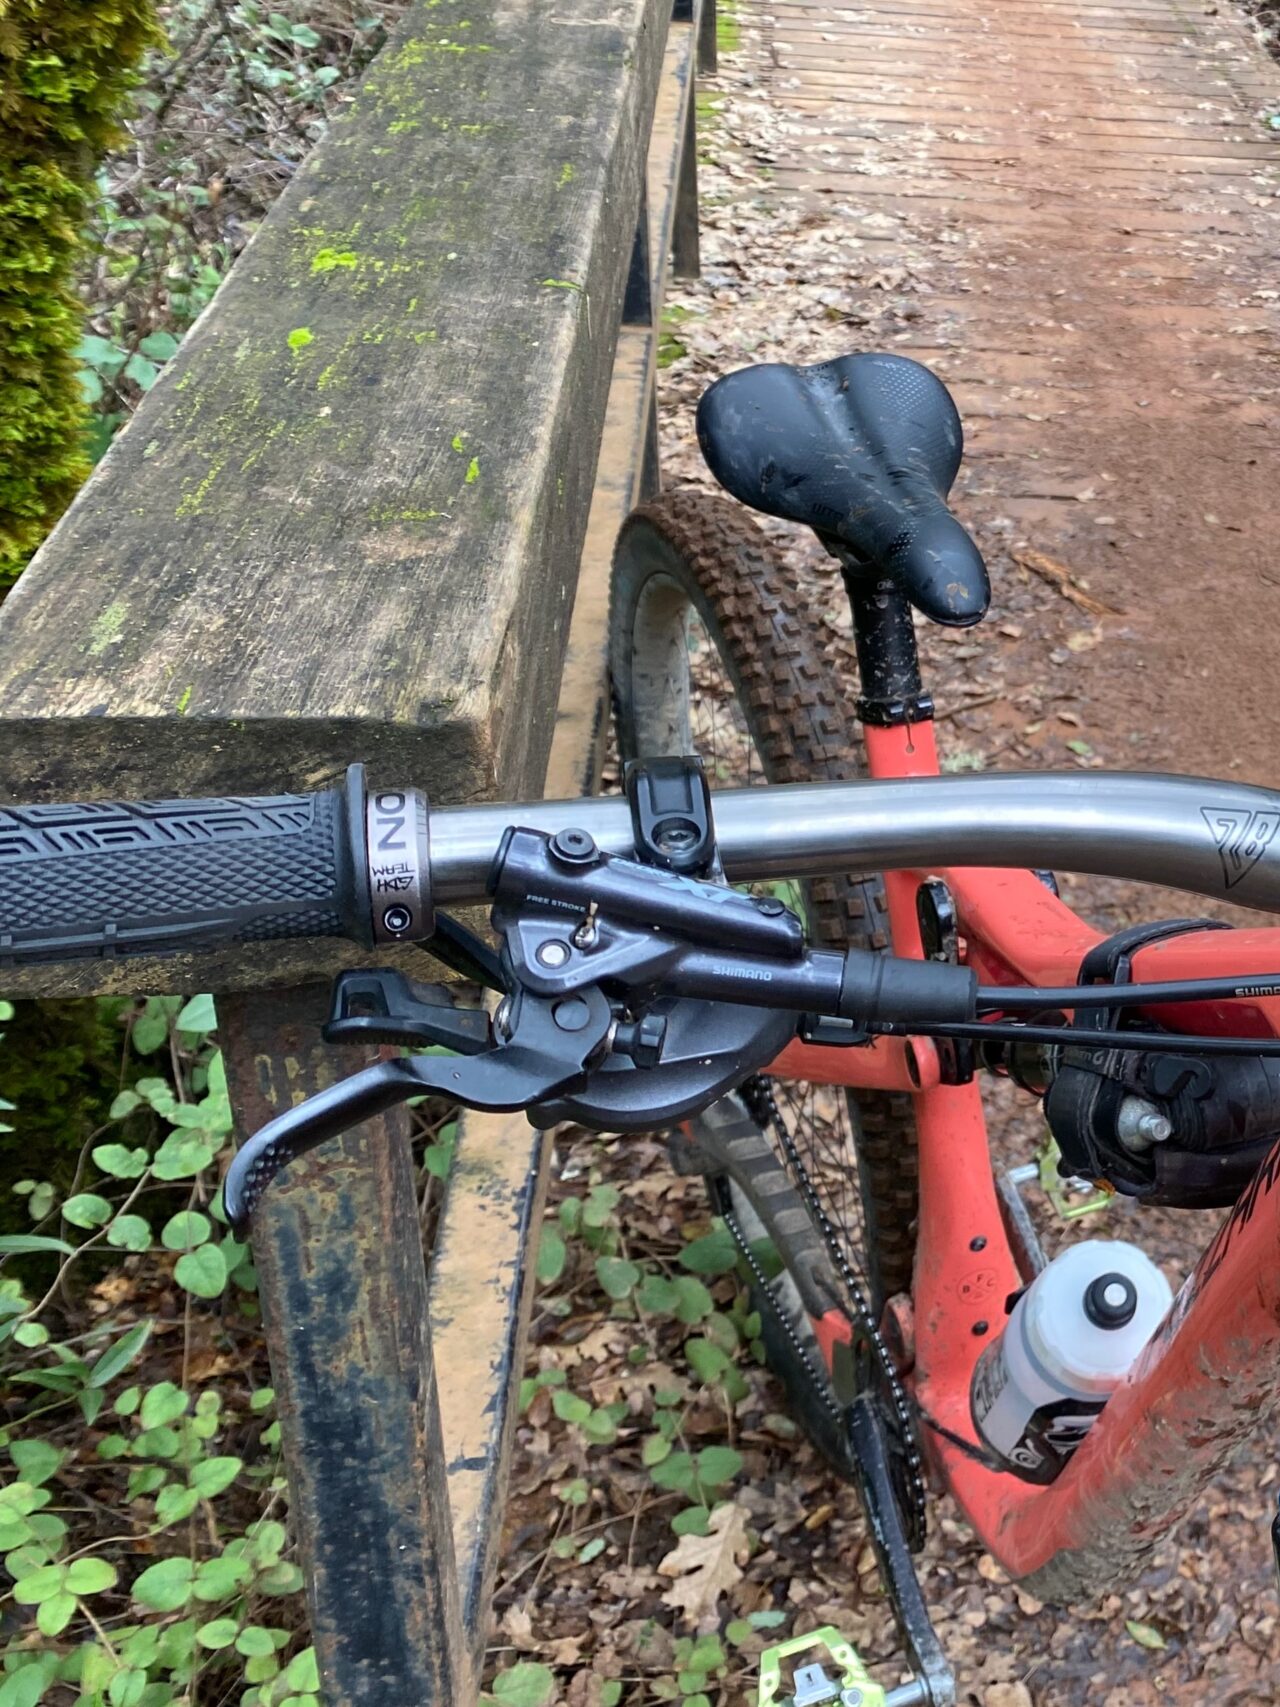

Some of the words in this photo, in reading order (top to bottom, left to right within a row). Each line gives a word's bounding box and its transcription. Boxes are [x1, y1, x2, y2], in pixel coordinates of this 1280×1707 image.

[371, 862, 416, 877] TEAM
[526, 894, 550, 905] FREE
[551, 898, 587, 913] STROKE
[712, 964, 772, 981] SHIMANO
